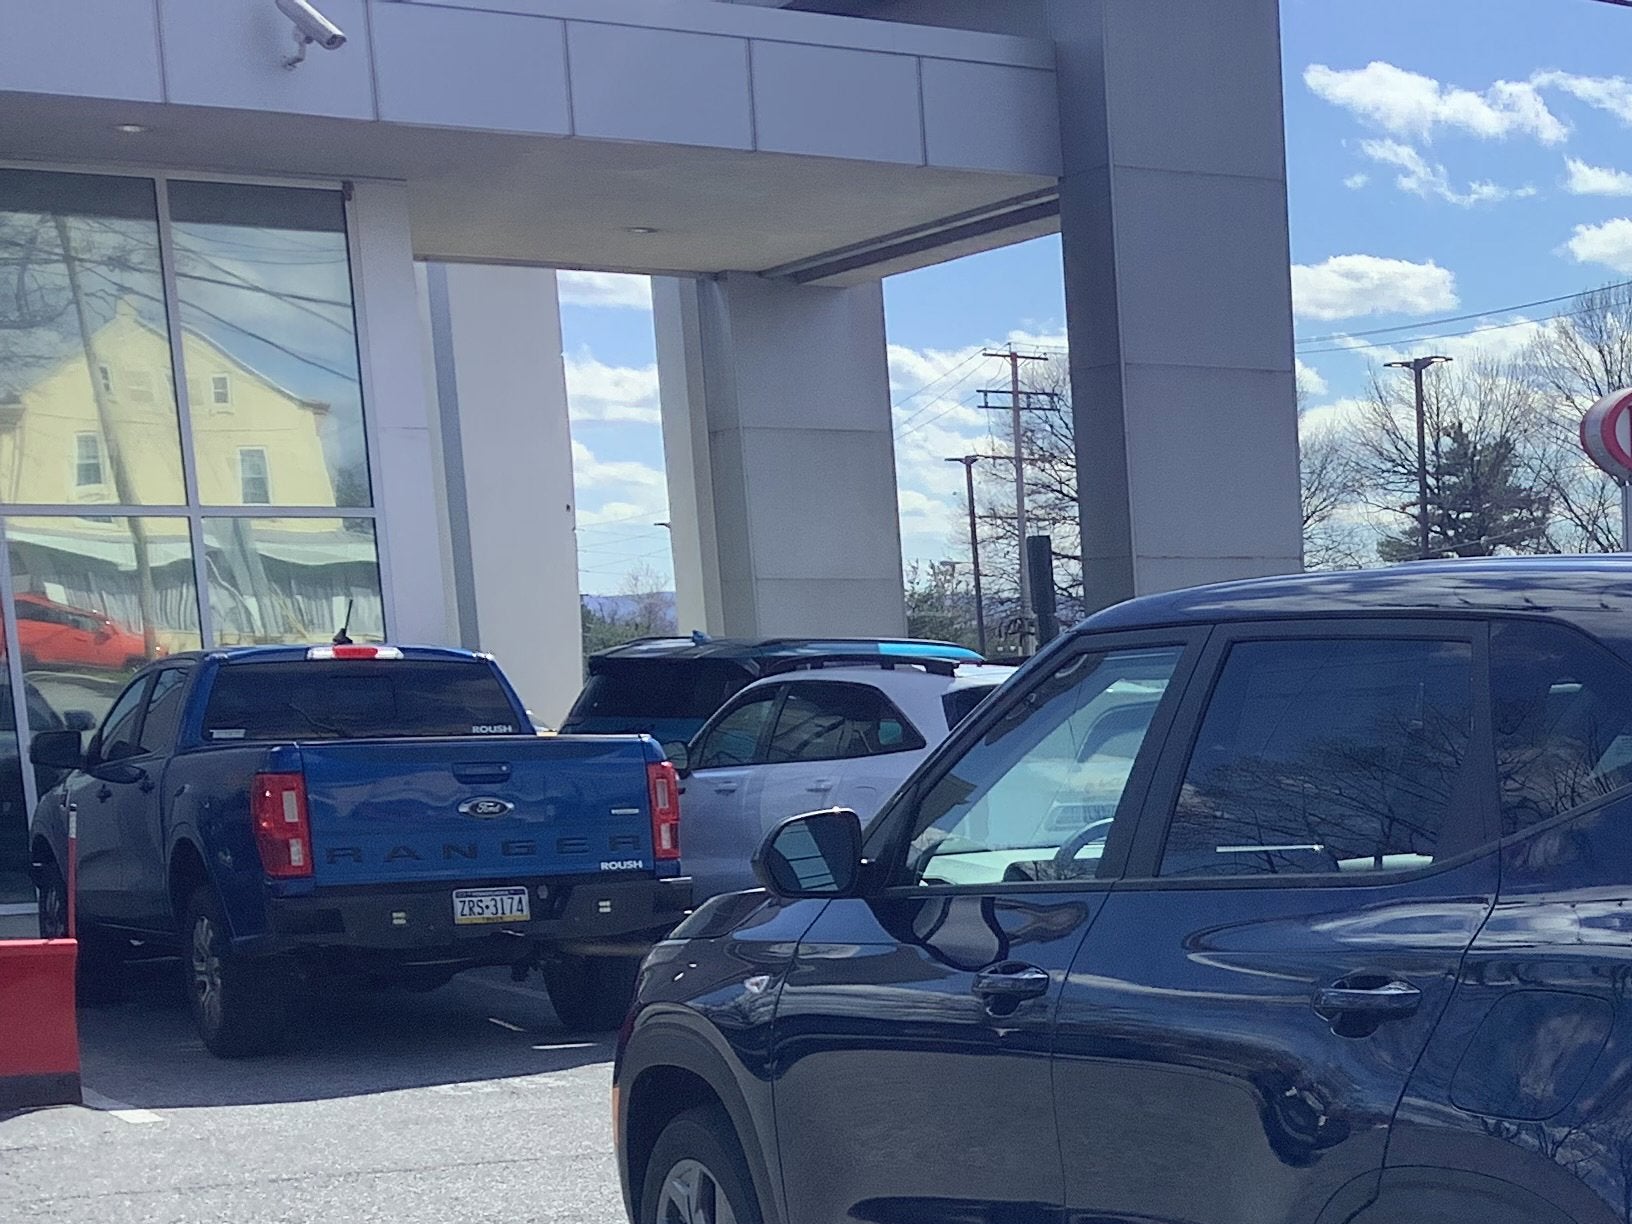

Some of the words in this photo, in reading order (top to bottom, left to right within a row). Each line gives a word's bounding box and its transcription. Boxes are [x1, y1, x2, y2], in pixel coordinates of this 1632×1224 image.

[472, 725, 512, 734] ROUSH
[326, 834, 641, 865] RANGER
[600, 860, 643, 870] ROUSH
